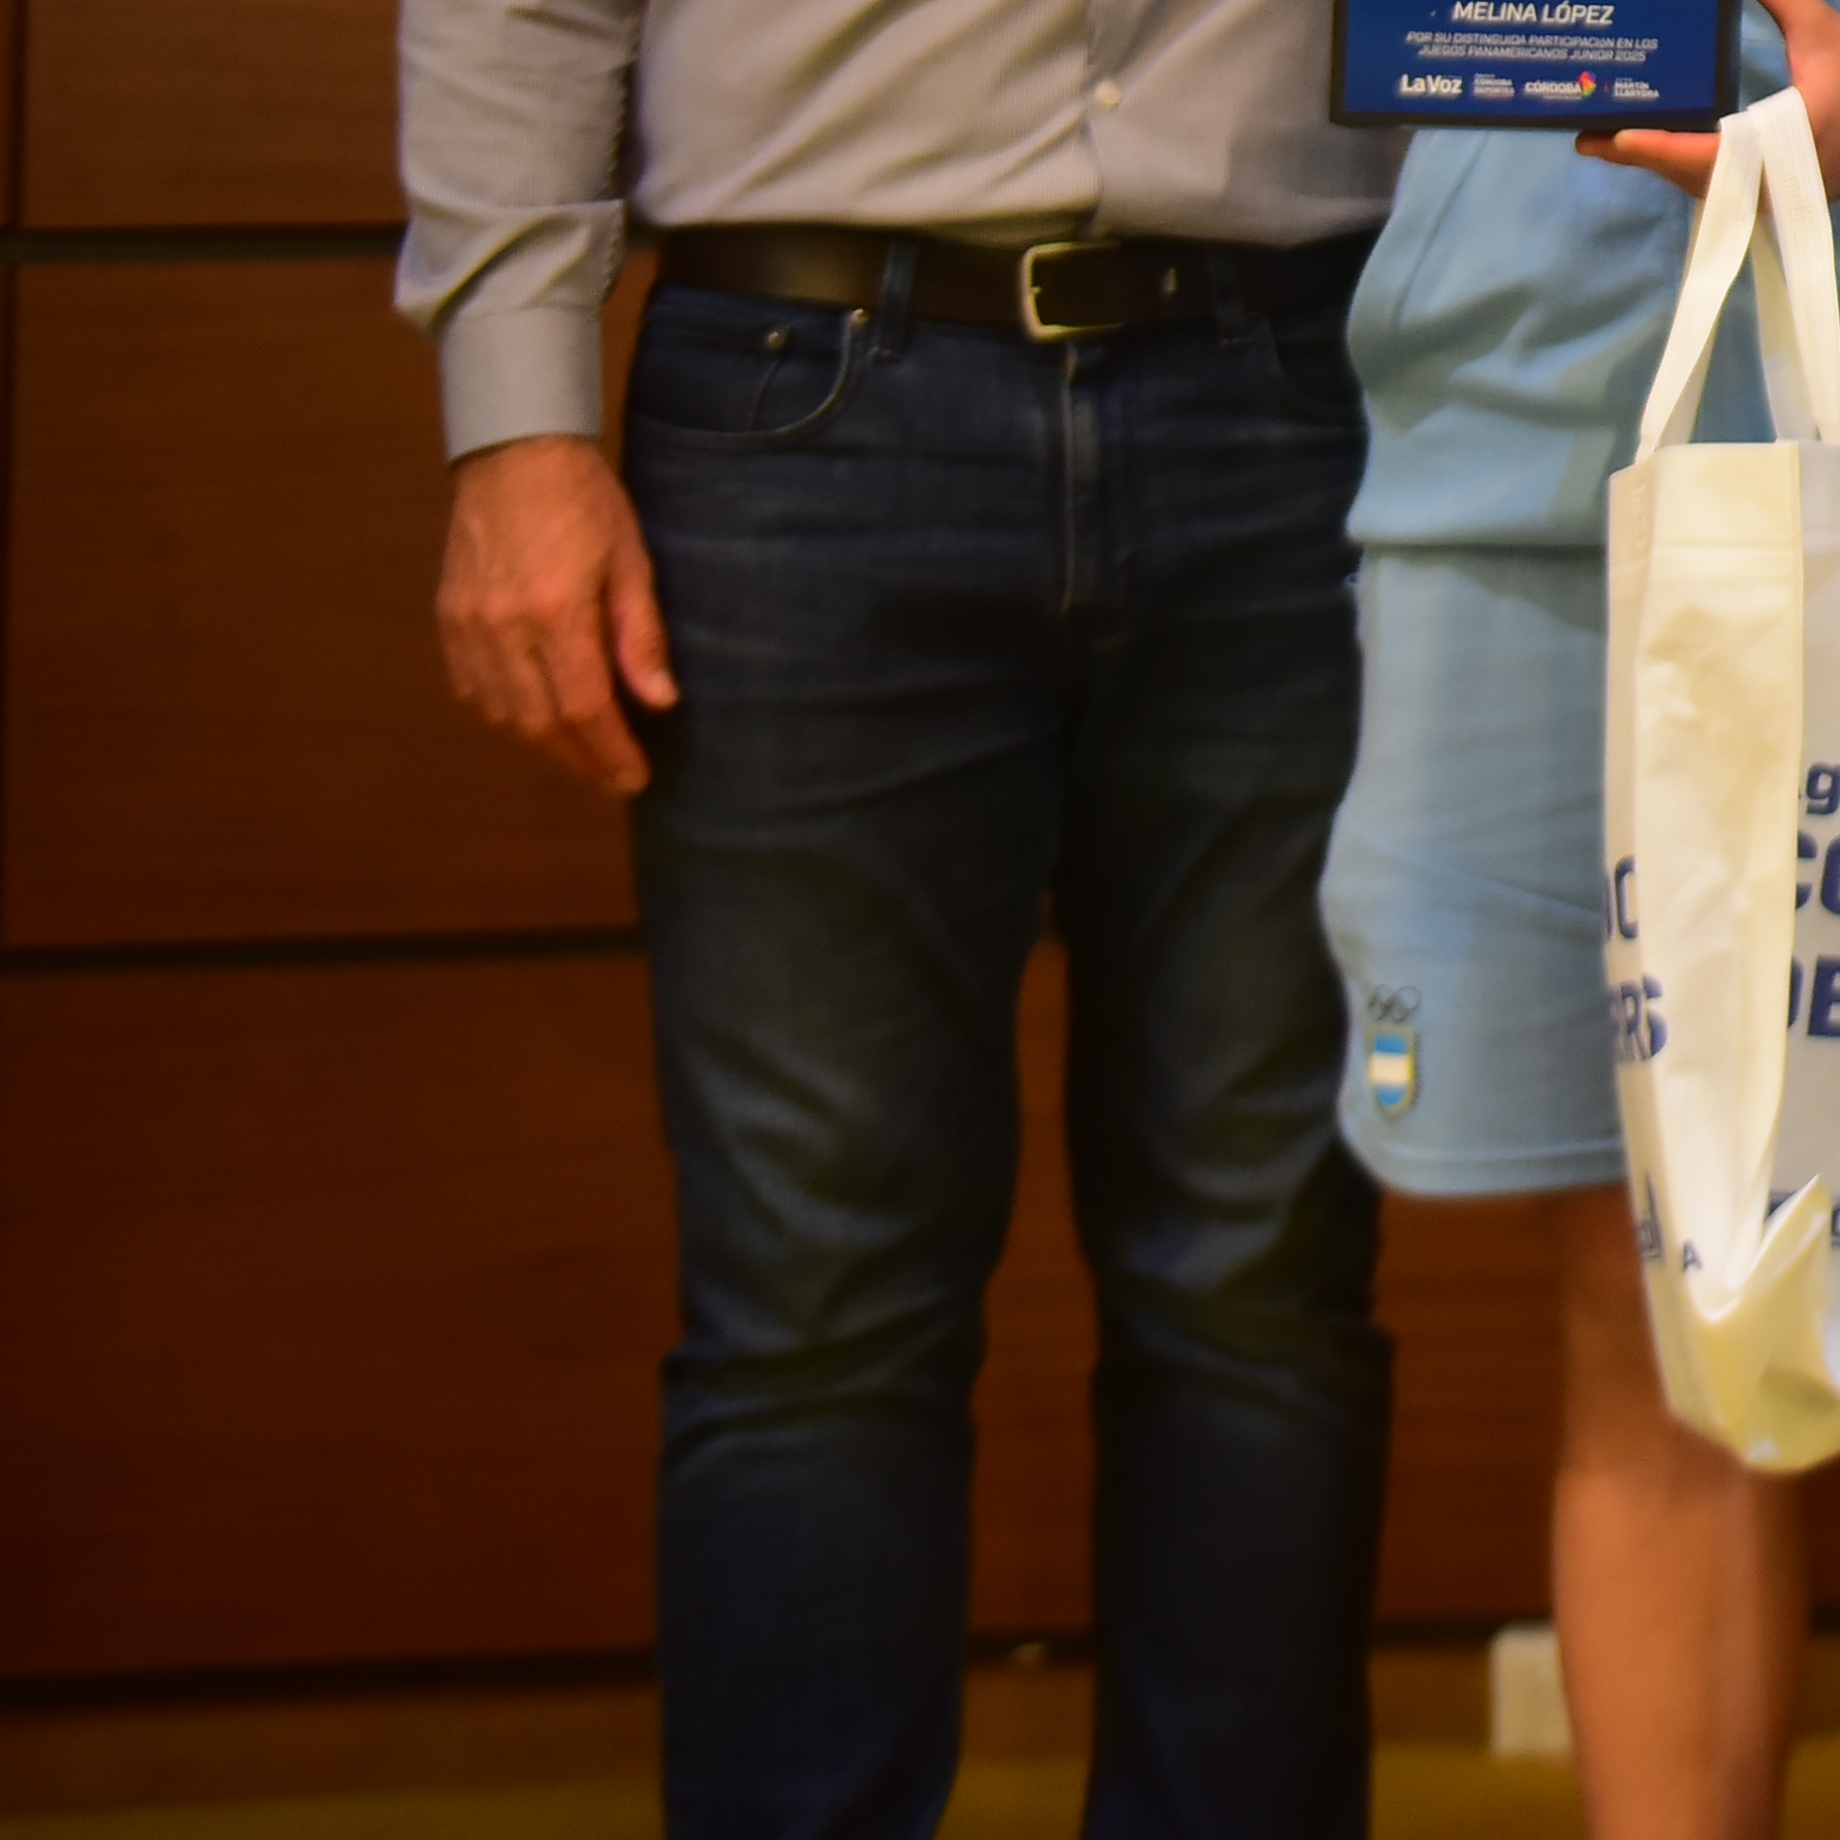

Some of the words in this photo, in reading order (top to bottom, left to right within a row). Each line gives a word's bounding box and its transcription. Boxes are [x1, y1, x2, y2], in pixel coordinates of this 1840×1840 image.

[1452, 1, 1537, 23] MELINA
[1542, 0, 1614, 25] LÓPEZ
[1406, 31, 1433, 44] POR
[1435, 32, 1451, 44] SU
[1452, 32, 1527, 47] DISTINGUIDA
[1616, 37, 1634, 49] EN
[1635, 38, 1658, 50] LOS
[1419, 44, 1466, 57] JUEGOS
